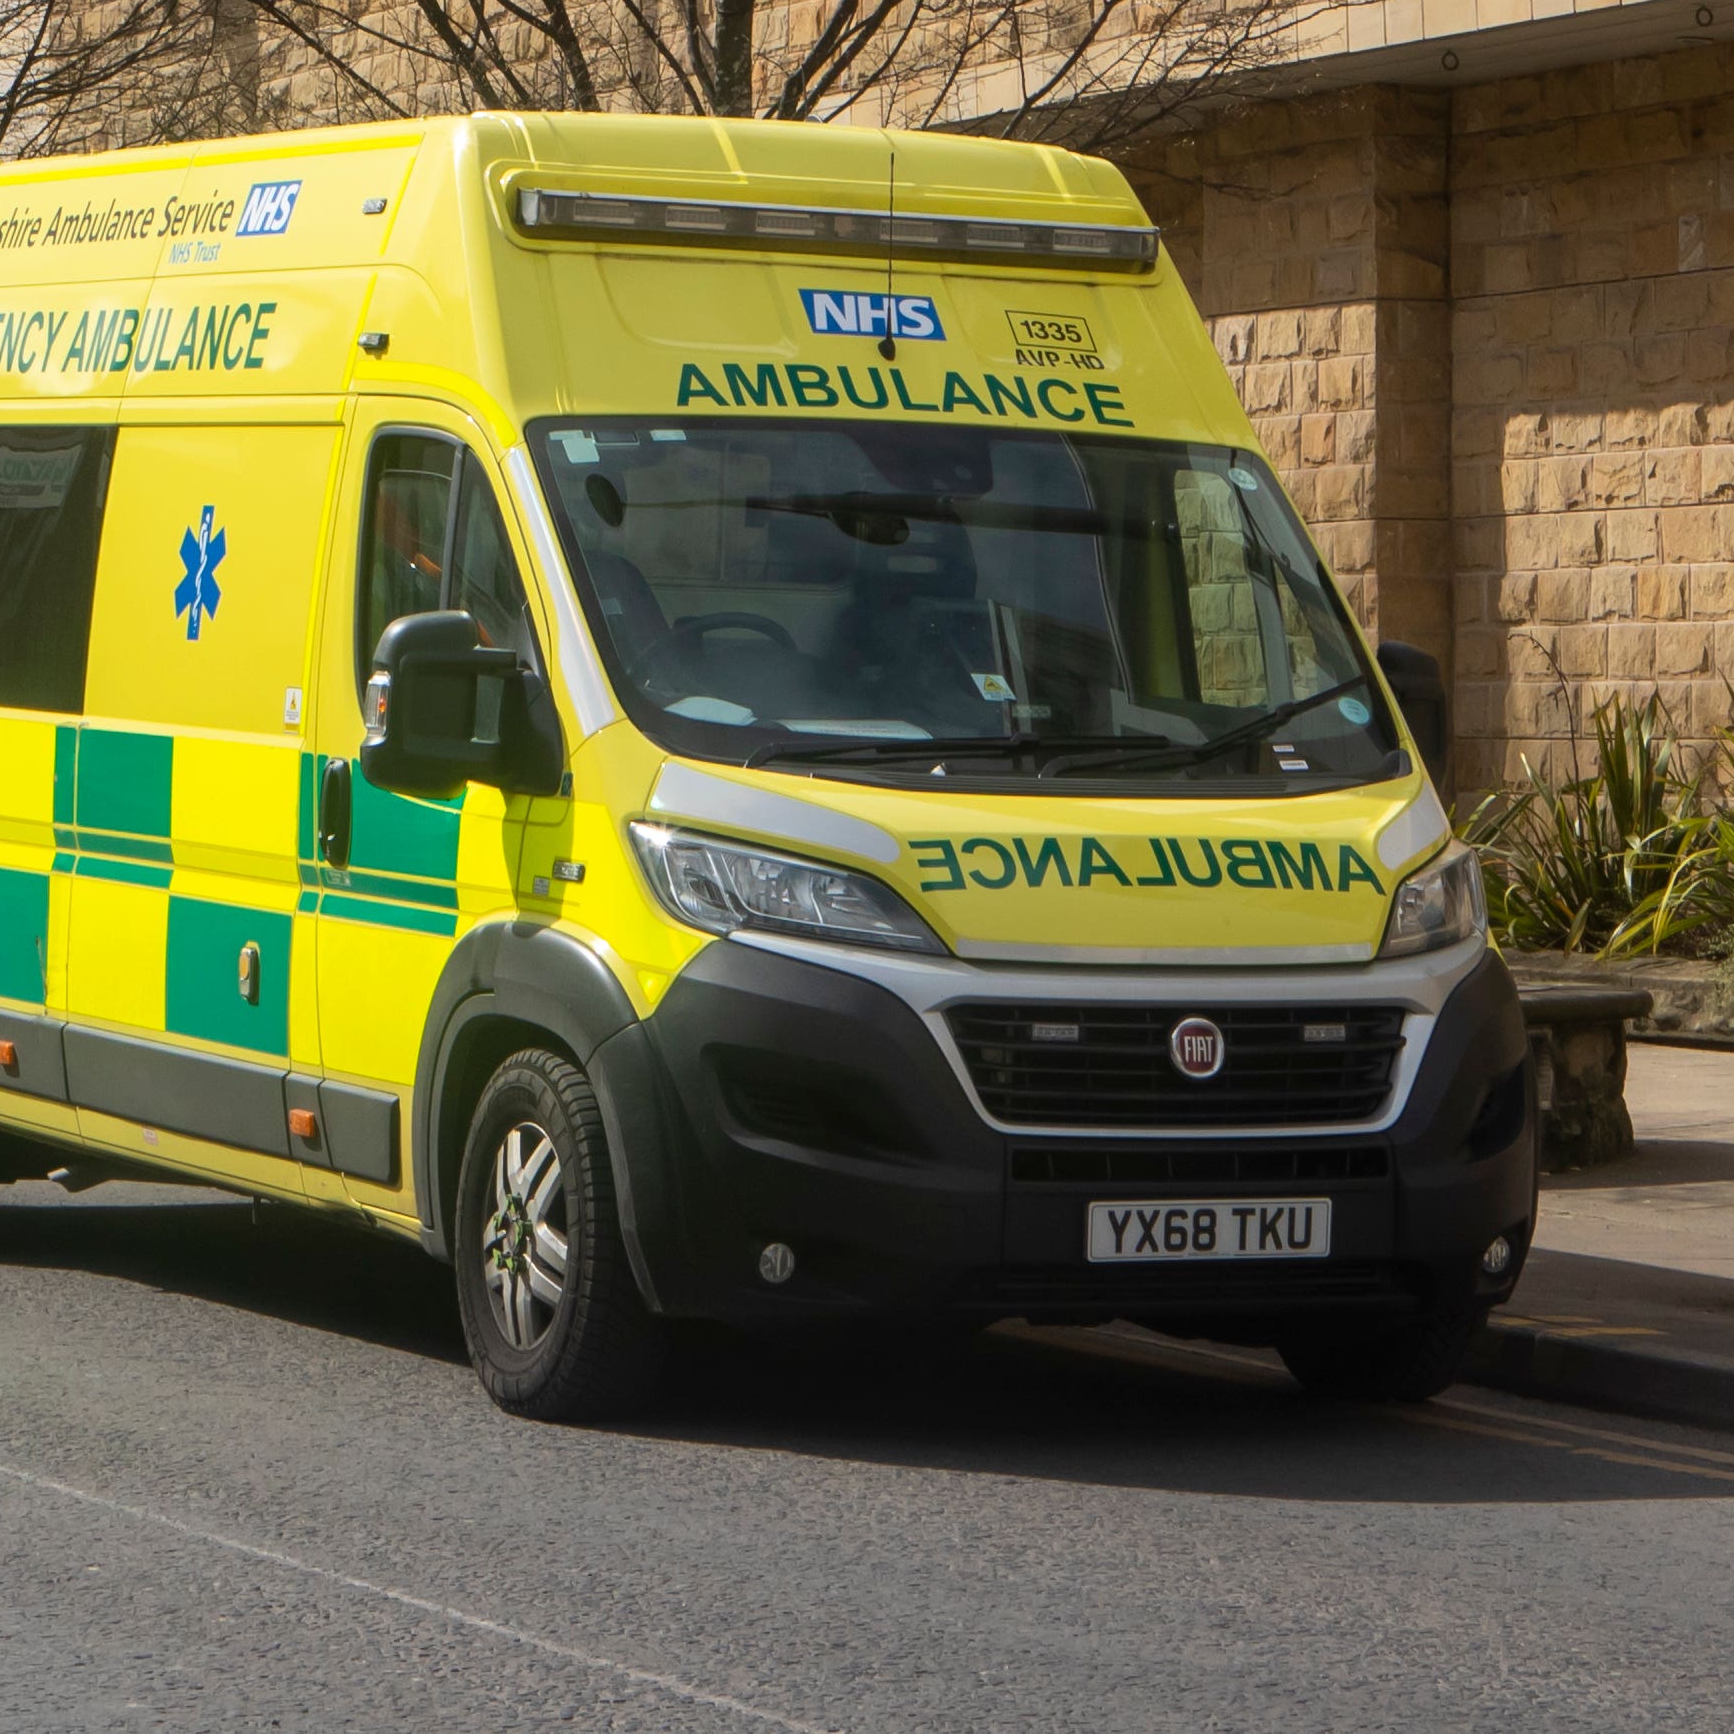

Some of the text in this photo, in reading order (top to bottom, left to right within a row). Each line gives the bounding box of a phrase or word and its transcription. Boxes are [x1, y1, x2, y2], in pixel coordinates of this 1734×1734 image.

[42, 198, 155, 247] Ambulance
[157, 189, 234, 238] Service
[237, 181, 302, 235] NHS
[169, 241, 221, 265] NHS Trust
[62, 302, 278, 373] AMBULANCE
[812, 293, 936, 339] NHS
[1019, 319, 1082, 343] 1335
[1014, 348, 1105, 370] AVP-HD
[677, 362, 1135, 428] AMBULANCE
[1183, 1035, 1214, 1063] FIAT
[1107, 1206, 1313, 1254] YX68 TKU
